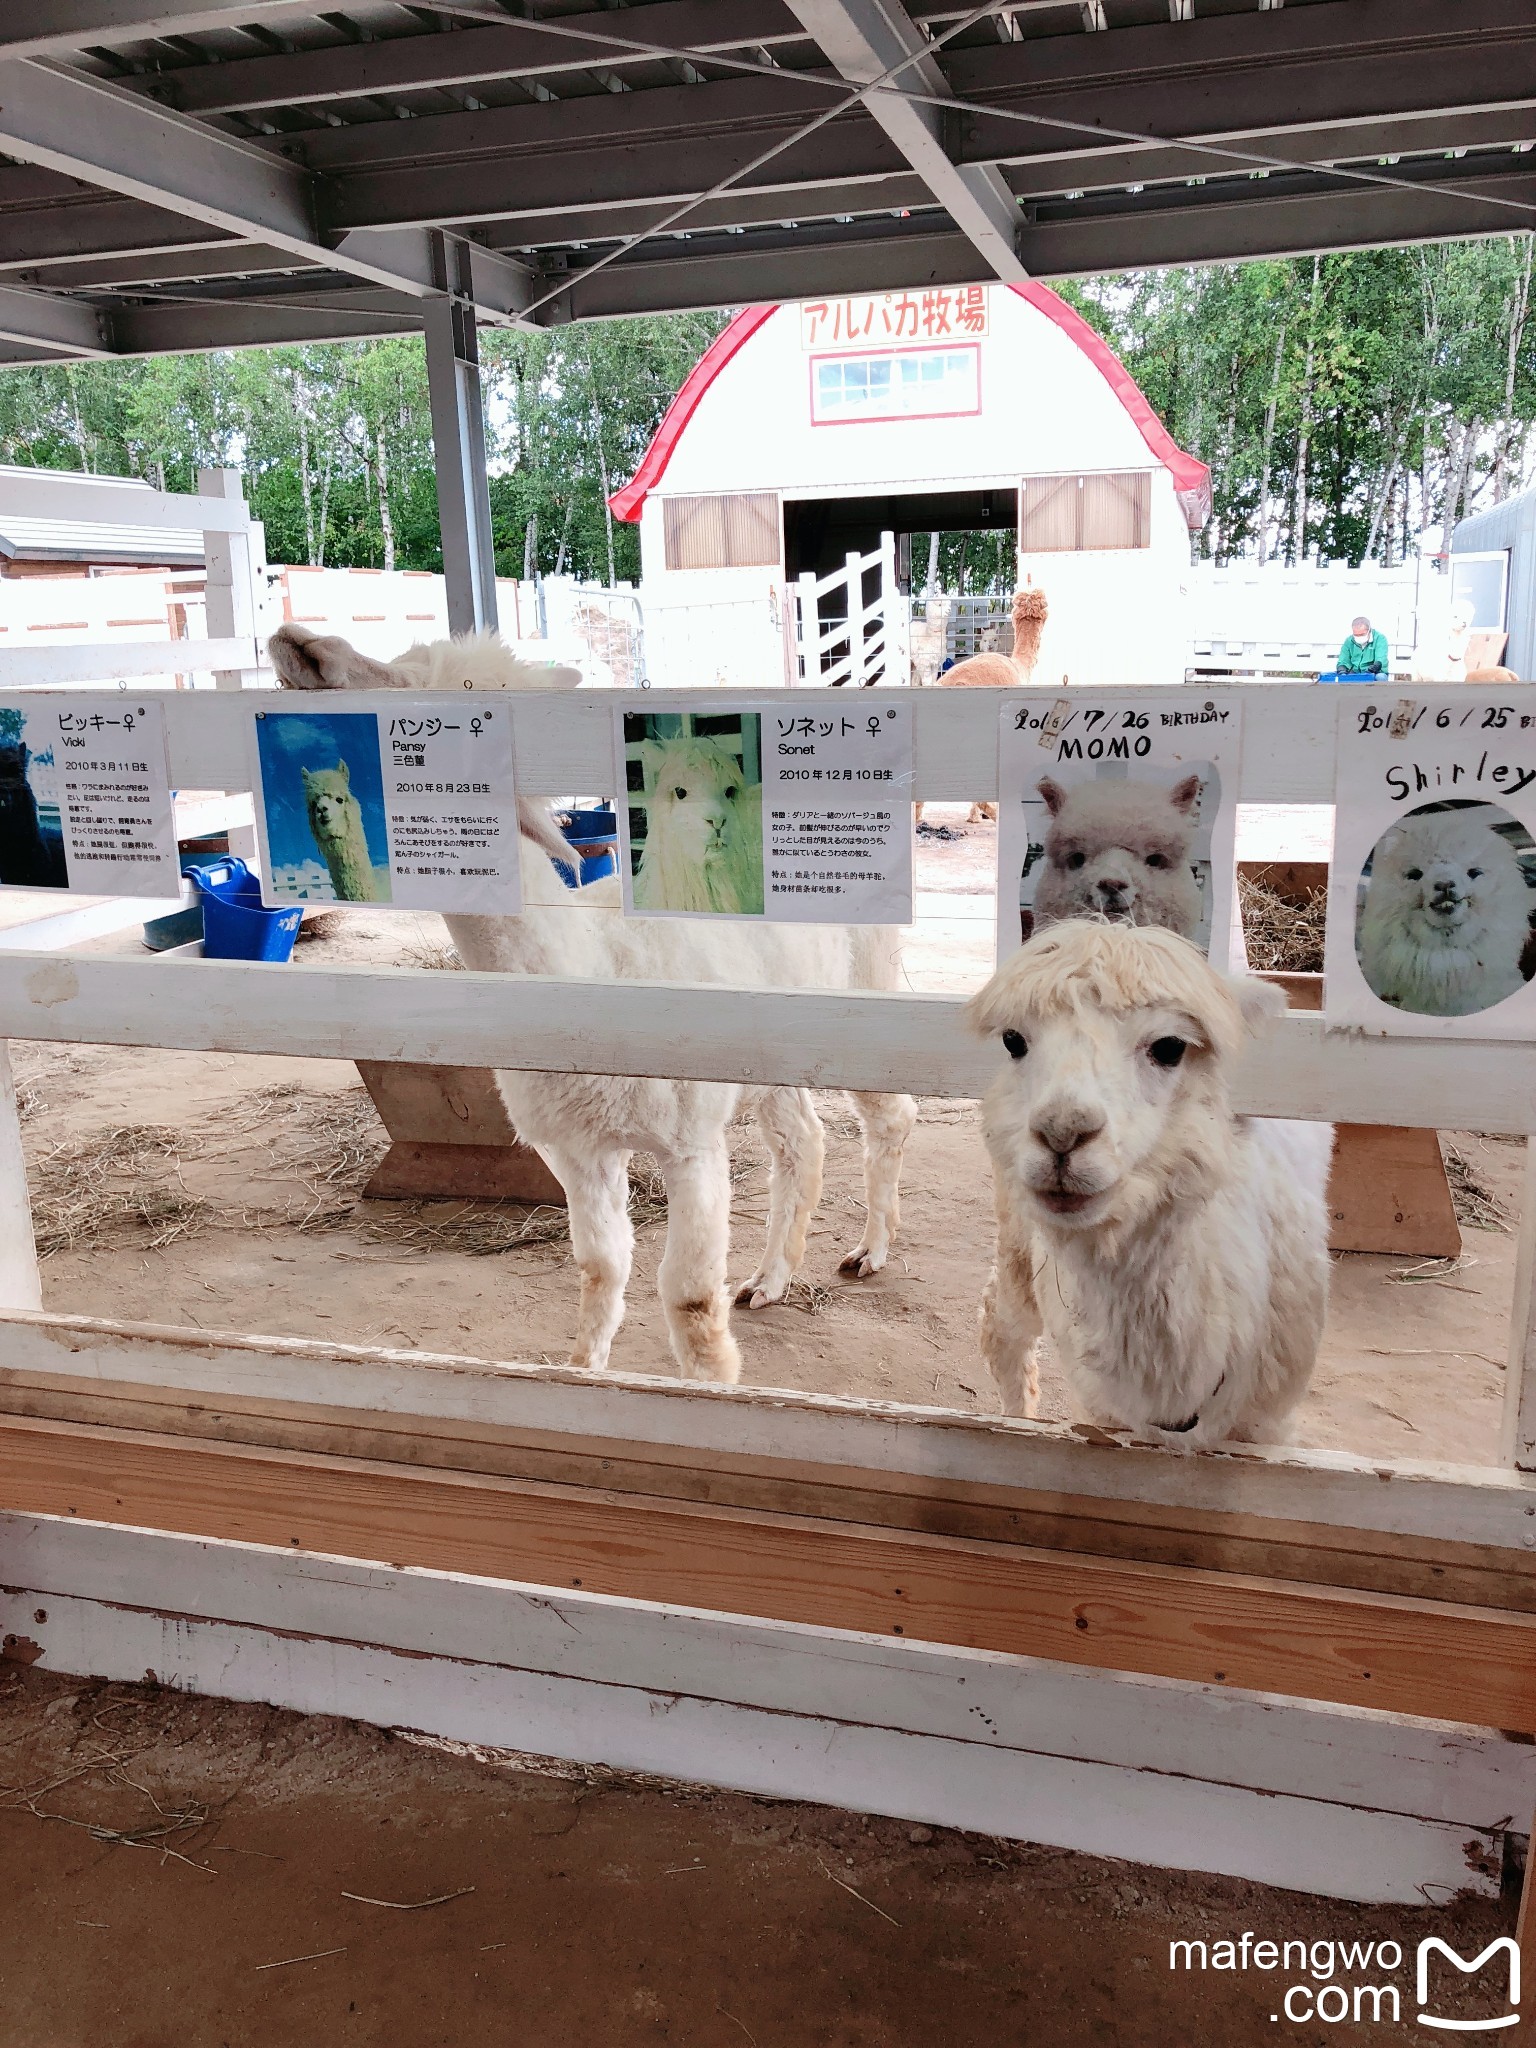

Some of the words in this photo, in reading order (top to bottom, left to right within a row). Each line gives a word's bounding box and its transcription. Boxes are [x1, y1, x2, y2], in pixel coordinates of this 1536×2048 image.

[804, 286, 986, 344] アルパカ牧場
[389, 717, 461, 737] パンジー
[777, 716, 855, 737] ソネット
[1160, 711, 1231, 728] BIRTHDAY
[61, 736, 86, 748] Vicki
[392, 740, 426, 753] Pansy
[778, 743, 815, 755] Sonet
[1057, 735, 1152, 763] MOMO
[1386, 750, 1536, 801] Shirley
